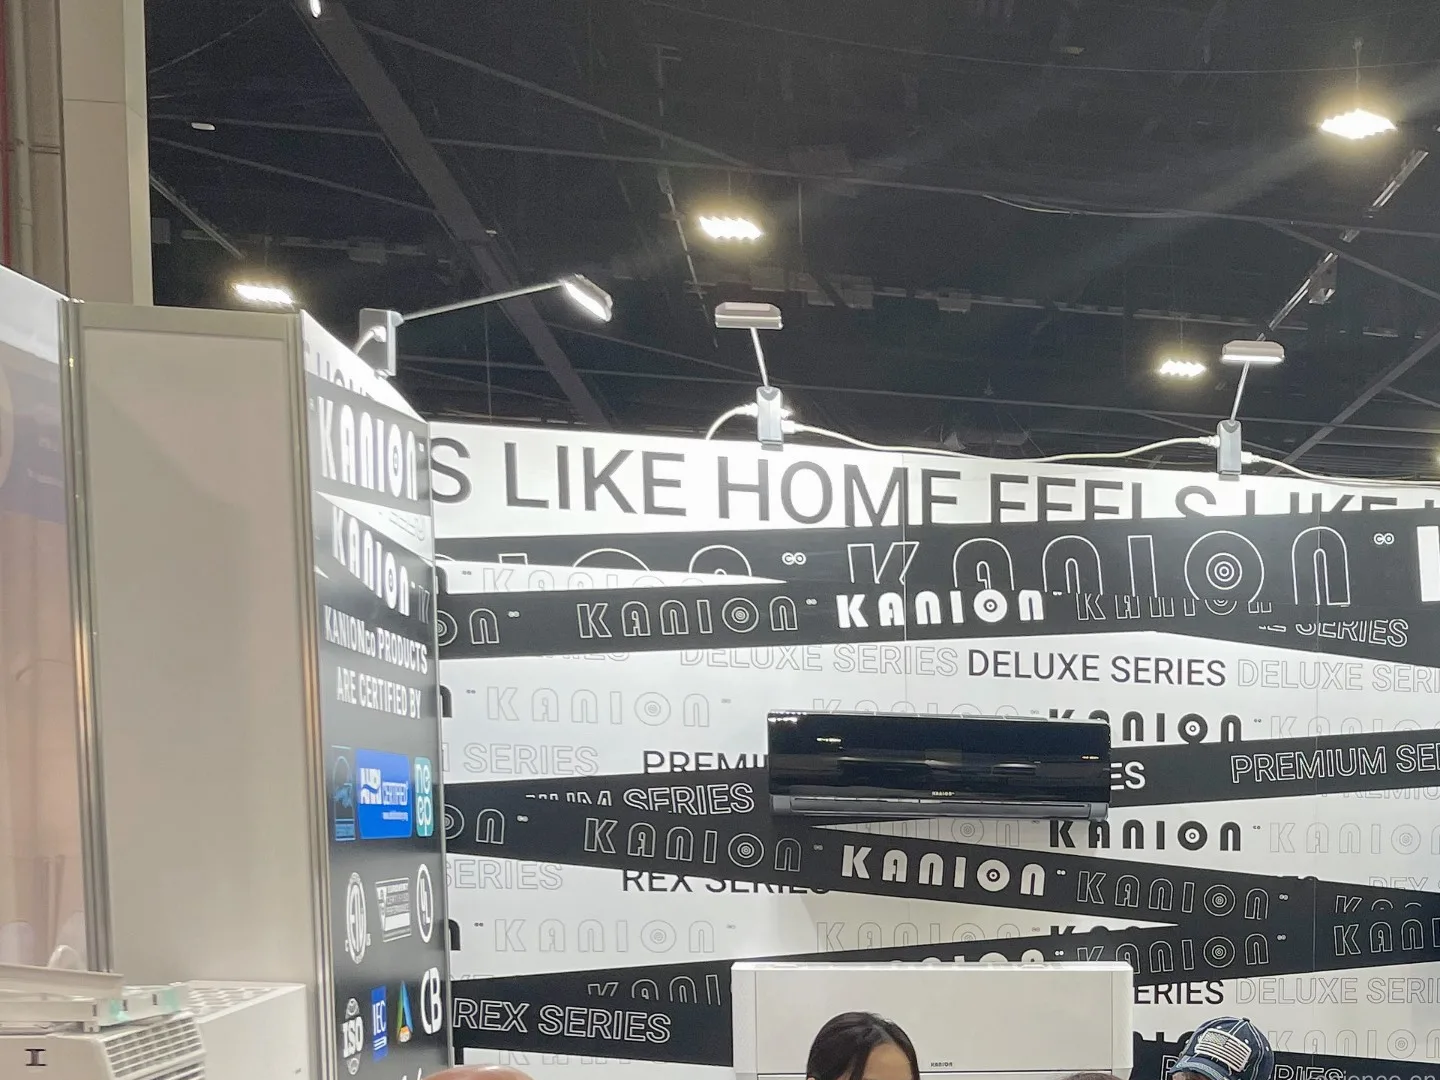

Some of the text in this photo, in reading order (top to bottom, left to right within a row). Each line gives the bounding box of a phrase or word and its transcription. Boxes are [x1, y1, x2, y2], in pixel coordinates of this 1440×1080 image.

[317, 396, 418, 501] KANION
[504, 442, 686, 517] LIKE
[718, 456, 962, 527] HOME
[332, 504, 410, 617] KANION
[577, 596, 799, 639] KANION
[836, 588, 1045, 629] KANION
[378, 627, 428, 675] PRODUCTS
[969, 649, 1100, 682] DELUXE
[1111, 656, 1227, 687] SERIES
[337, 667, 422, 720] ARE CERTIFIED BY
[1230, 746, 1387, 785] PREMIUM
[584, 817, 802, 873] KANION
[1049, 819, 1242, 852] KANION
[842, 845, 1270, 921] KANION KANION
[343, 1016, 364, 1059] ISO
[372, 1001, 387, 1037] IEC
[453, 998, 672, 1045] REX SERIES
